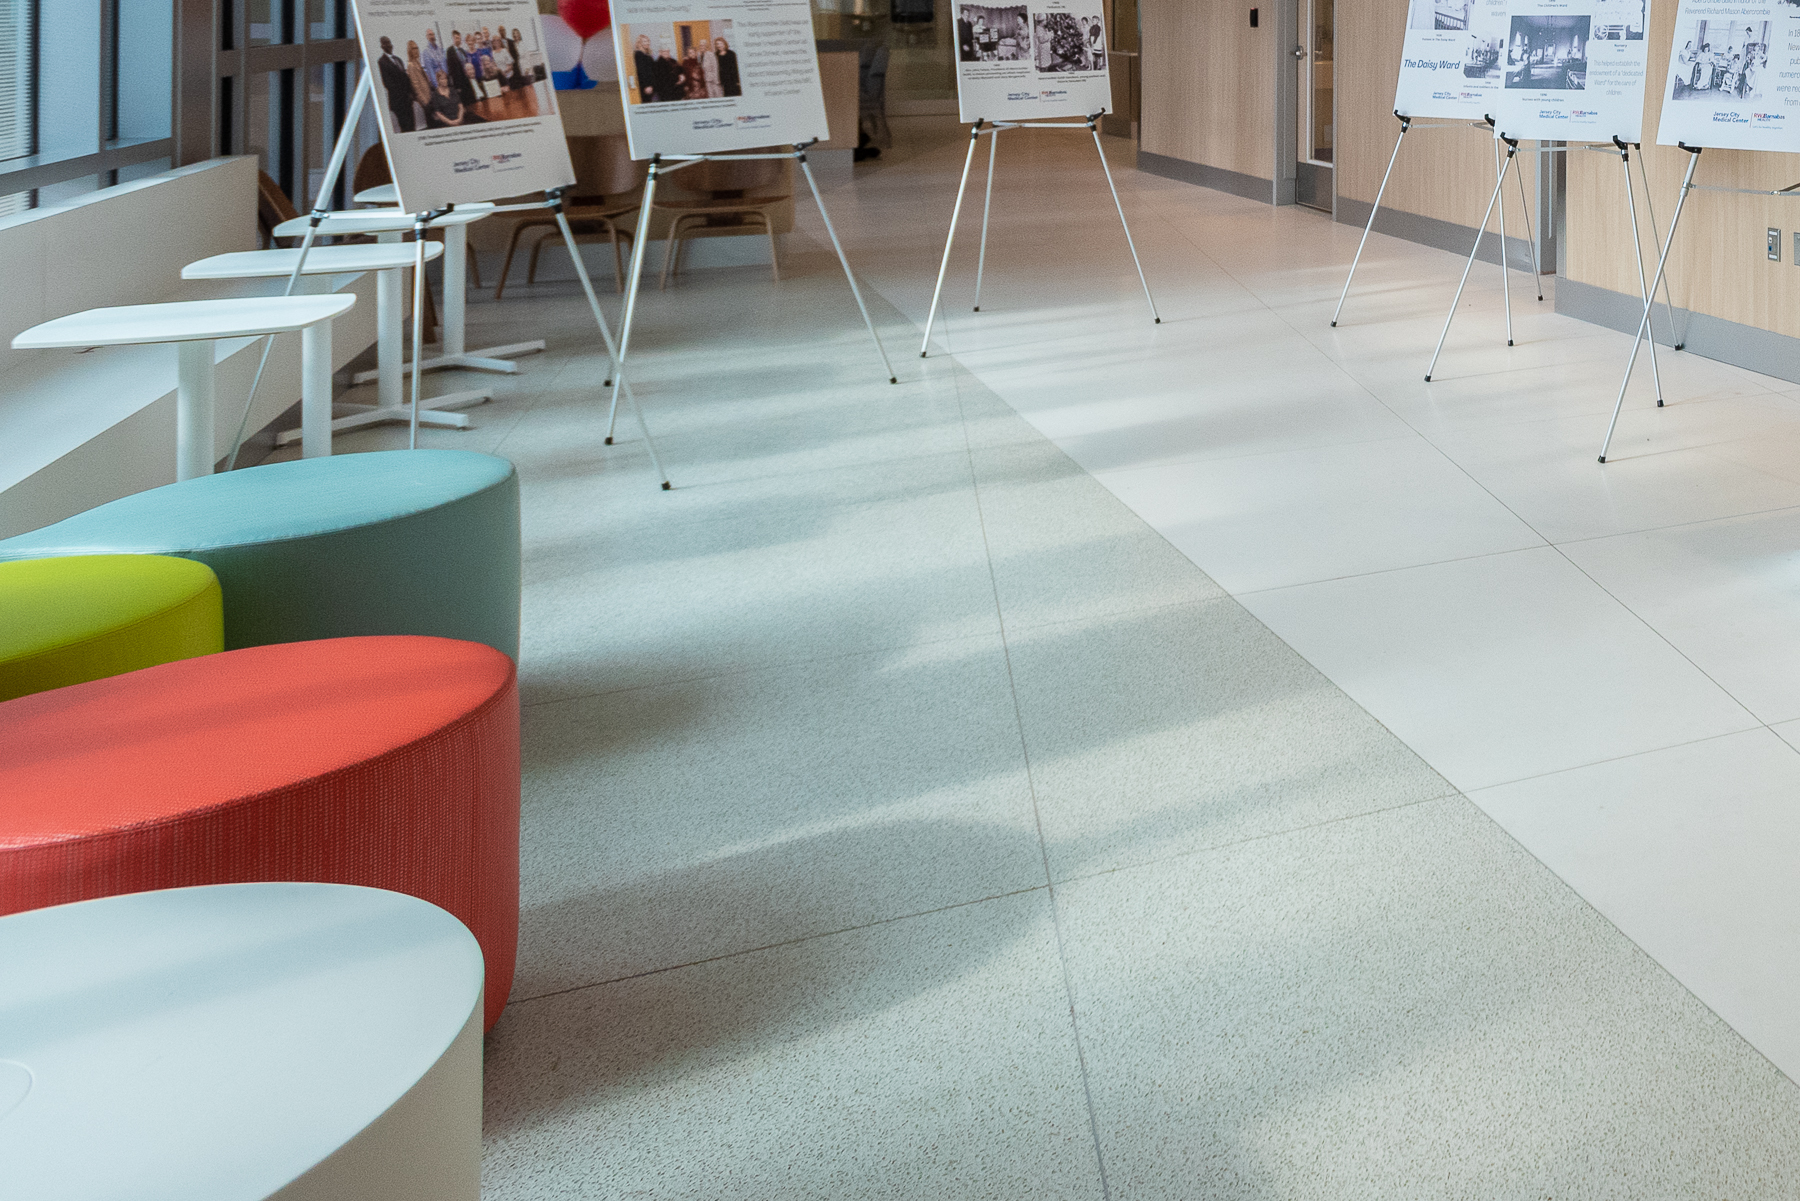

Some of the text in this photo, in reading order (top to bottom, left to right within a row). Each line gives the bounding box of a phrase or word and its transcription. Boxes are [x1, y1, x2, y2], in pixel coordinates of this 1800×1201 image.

[1404, 60, 1460, 71] The Daisy Ward
[1784, 97, 1798, 106] from
